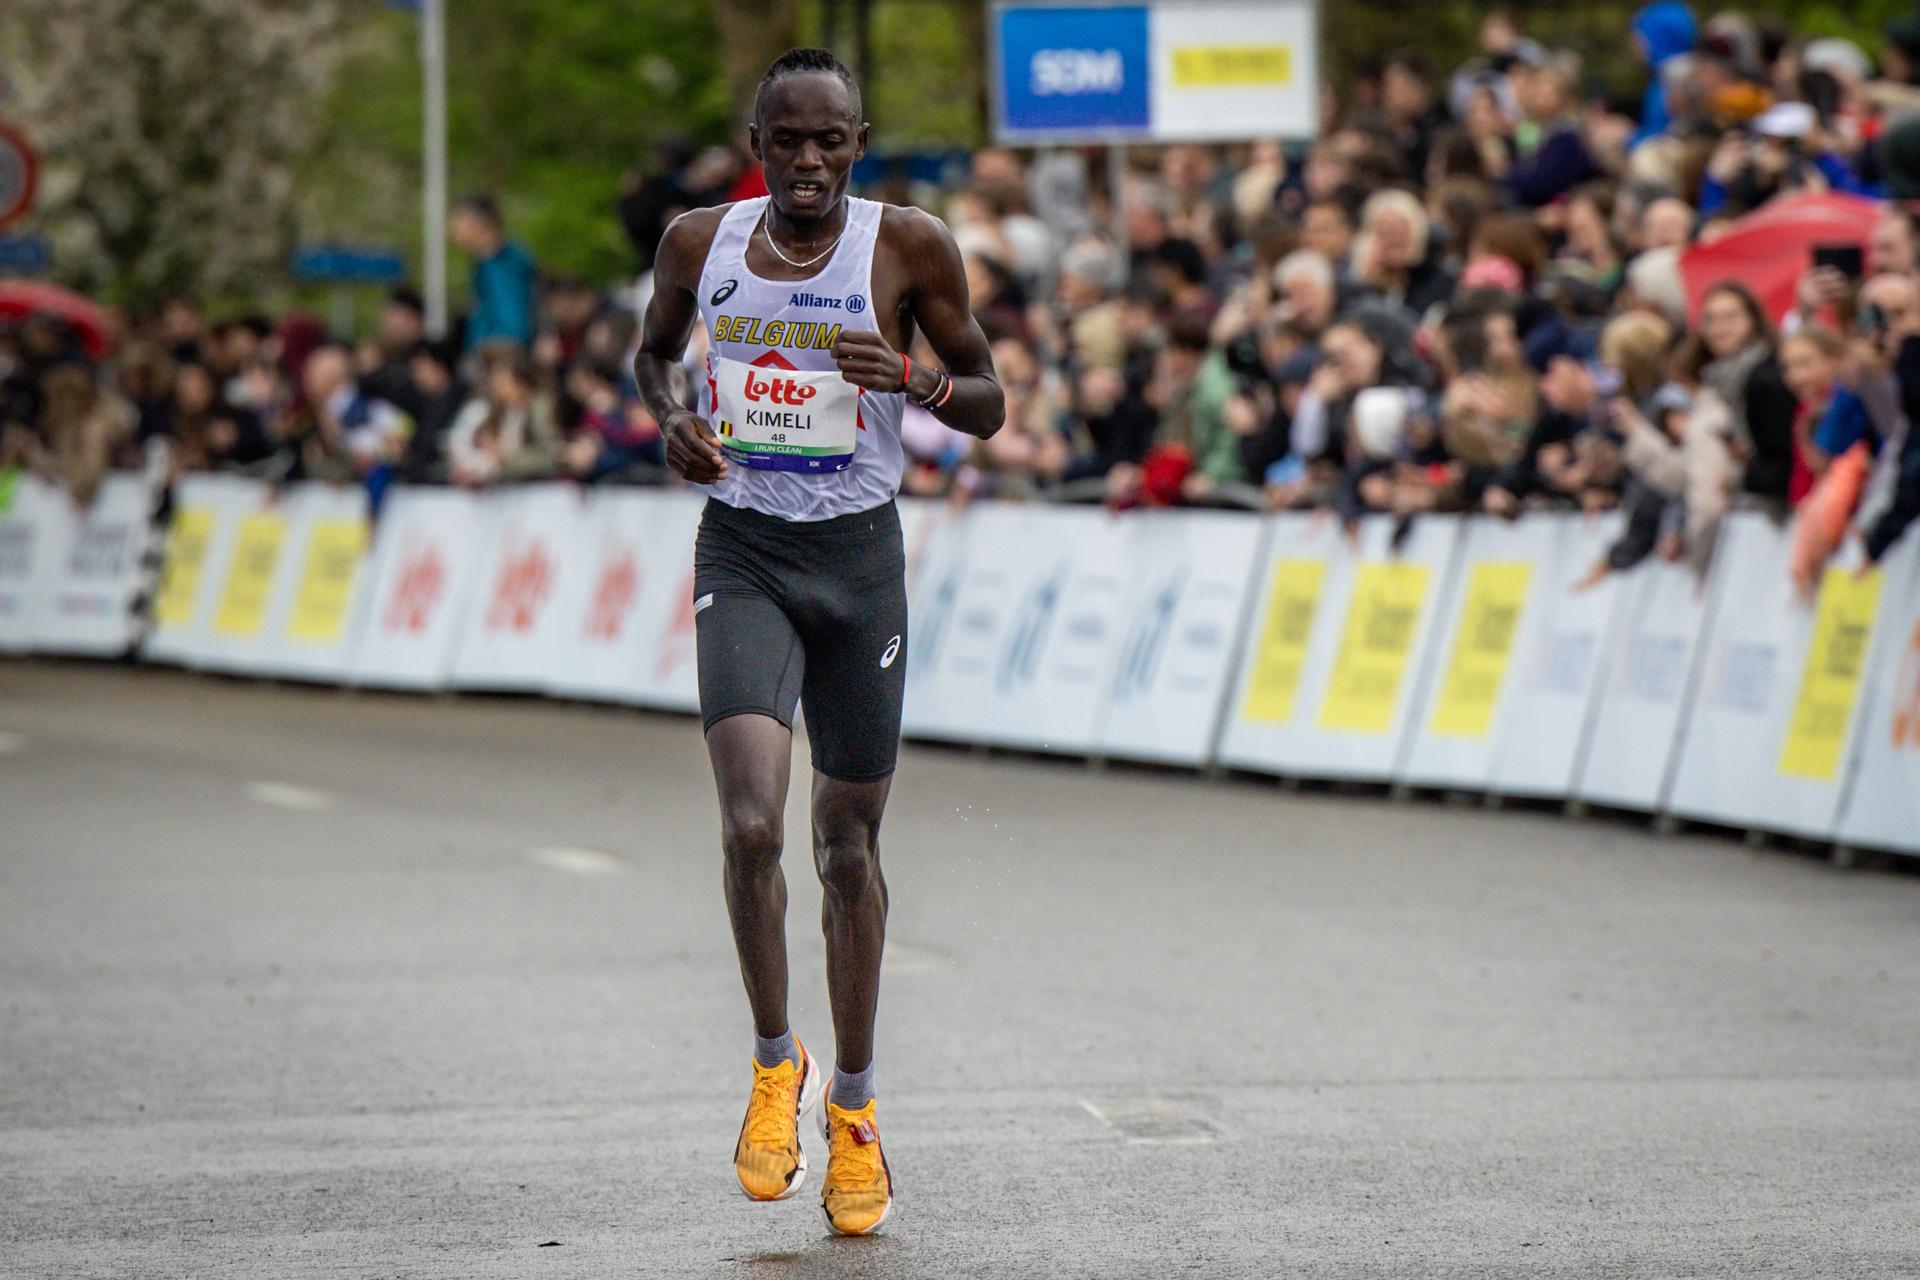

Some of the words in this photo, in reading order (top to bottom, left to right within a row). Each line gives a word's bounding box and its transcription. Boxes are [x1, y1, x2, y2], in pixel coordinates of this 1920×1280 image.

[788, 293, 842, 309] Allianz
[713, 314, 843, 351] BELGIUM
[746, 409, 811, 430] KIMELI
[770, 433, 786, 443] 48
[776, 446, 802, 454] CLEAN
